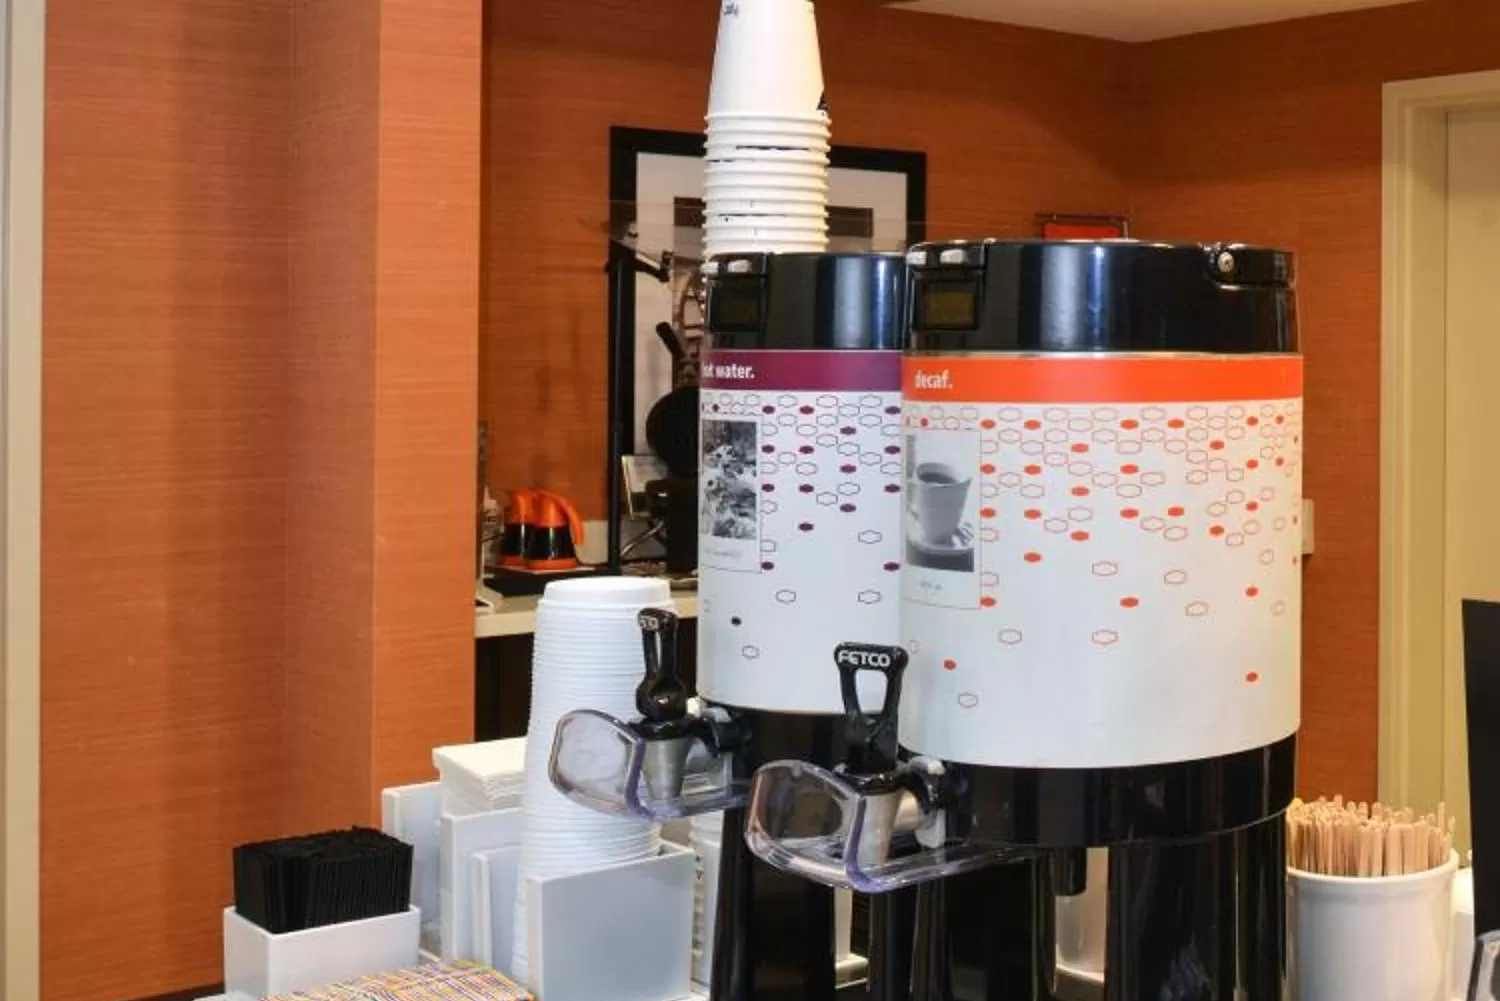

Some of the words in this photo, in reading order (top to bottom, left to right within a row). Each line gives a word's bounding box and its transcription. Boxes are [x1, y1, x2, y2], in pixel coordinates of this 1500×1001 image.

[715, 363, 756, 379] water.
[914, 369, 953, 389] decaf.
[838, 649, 891, 667] FETCO
